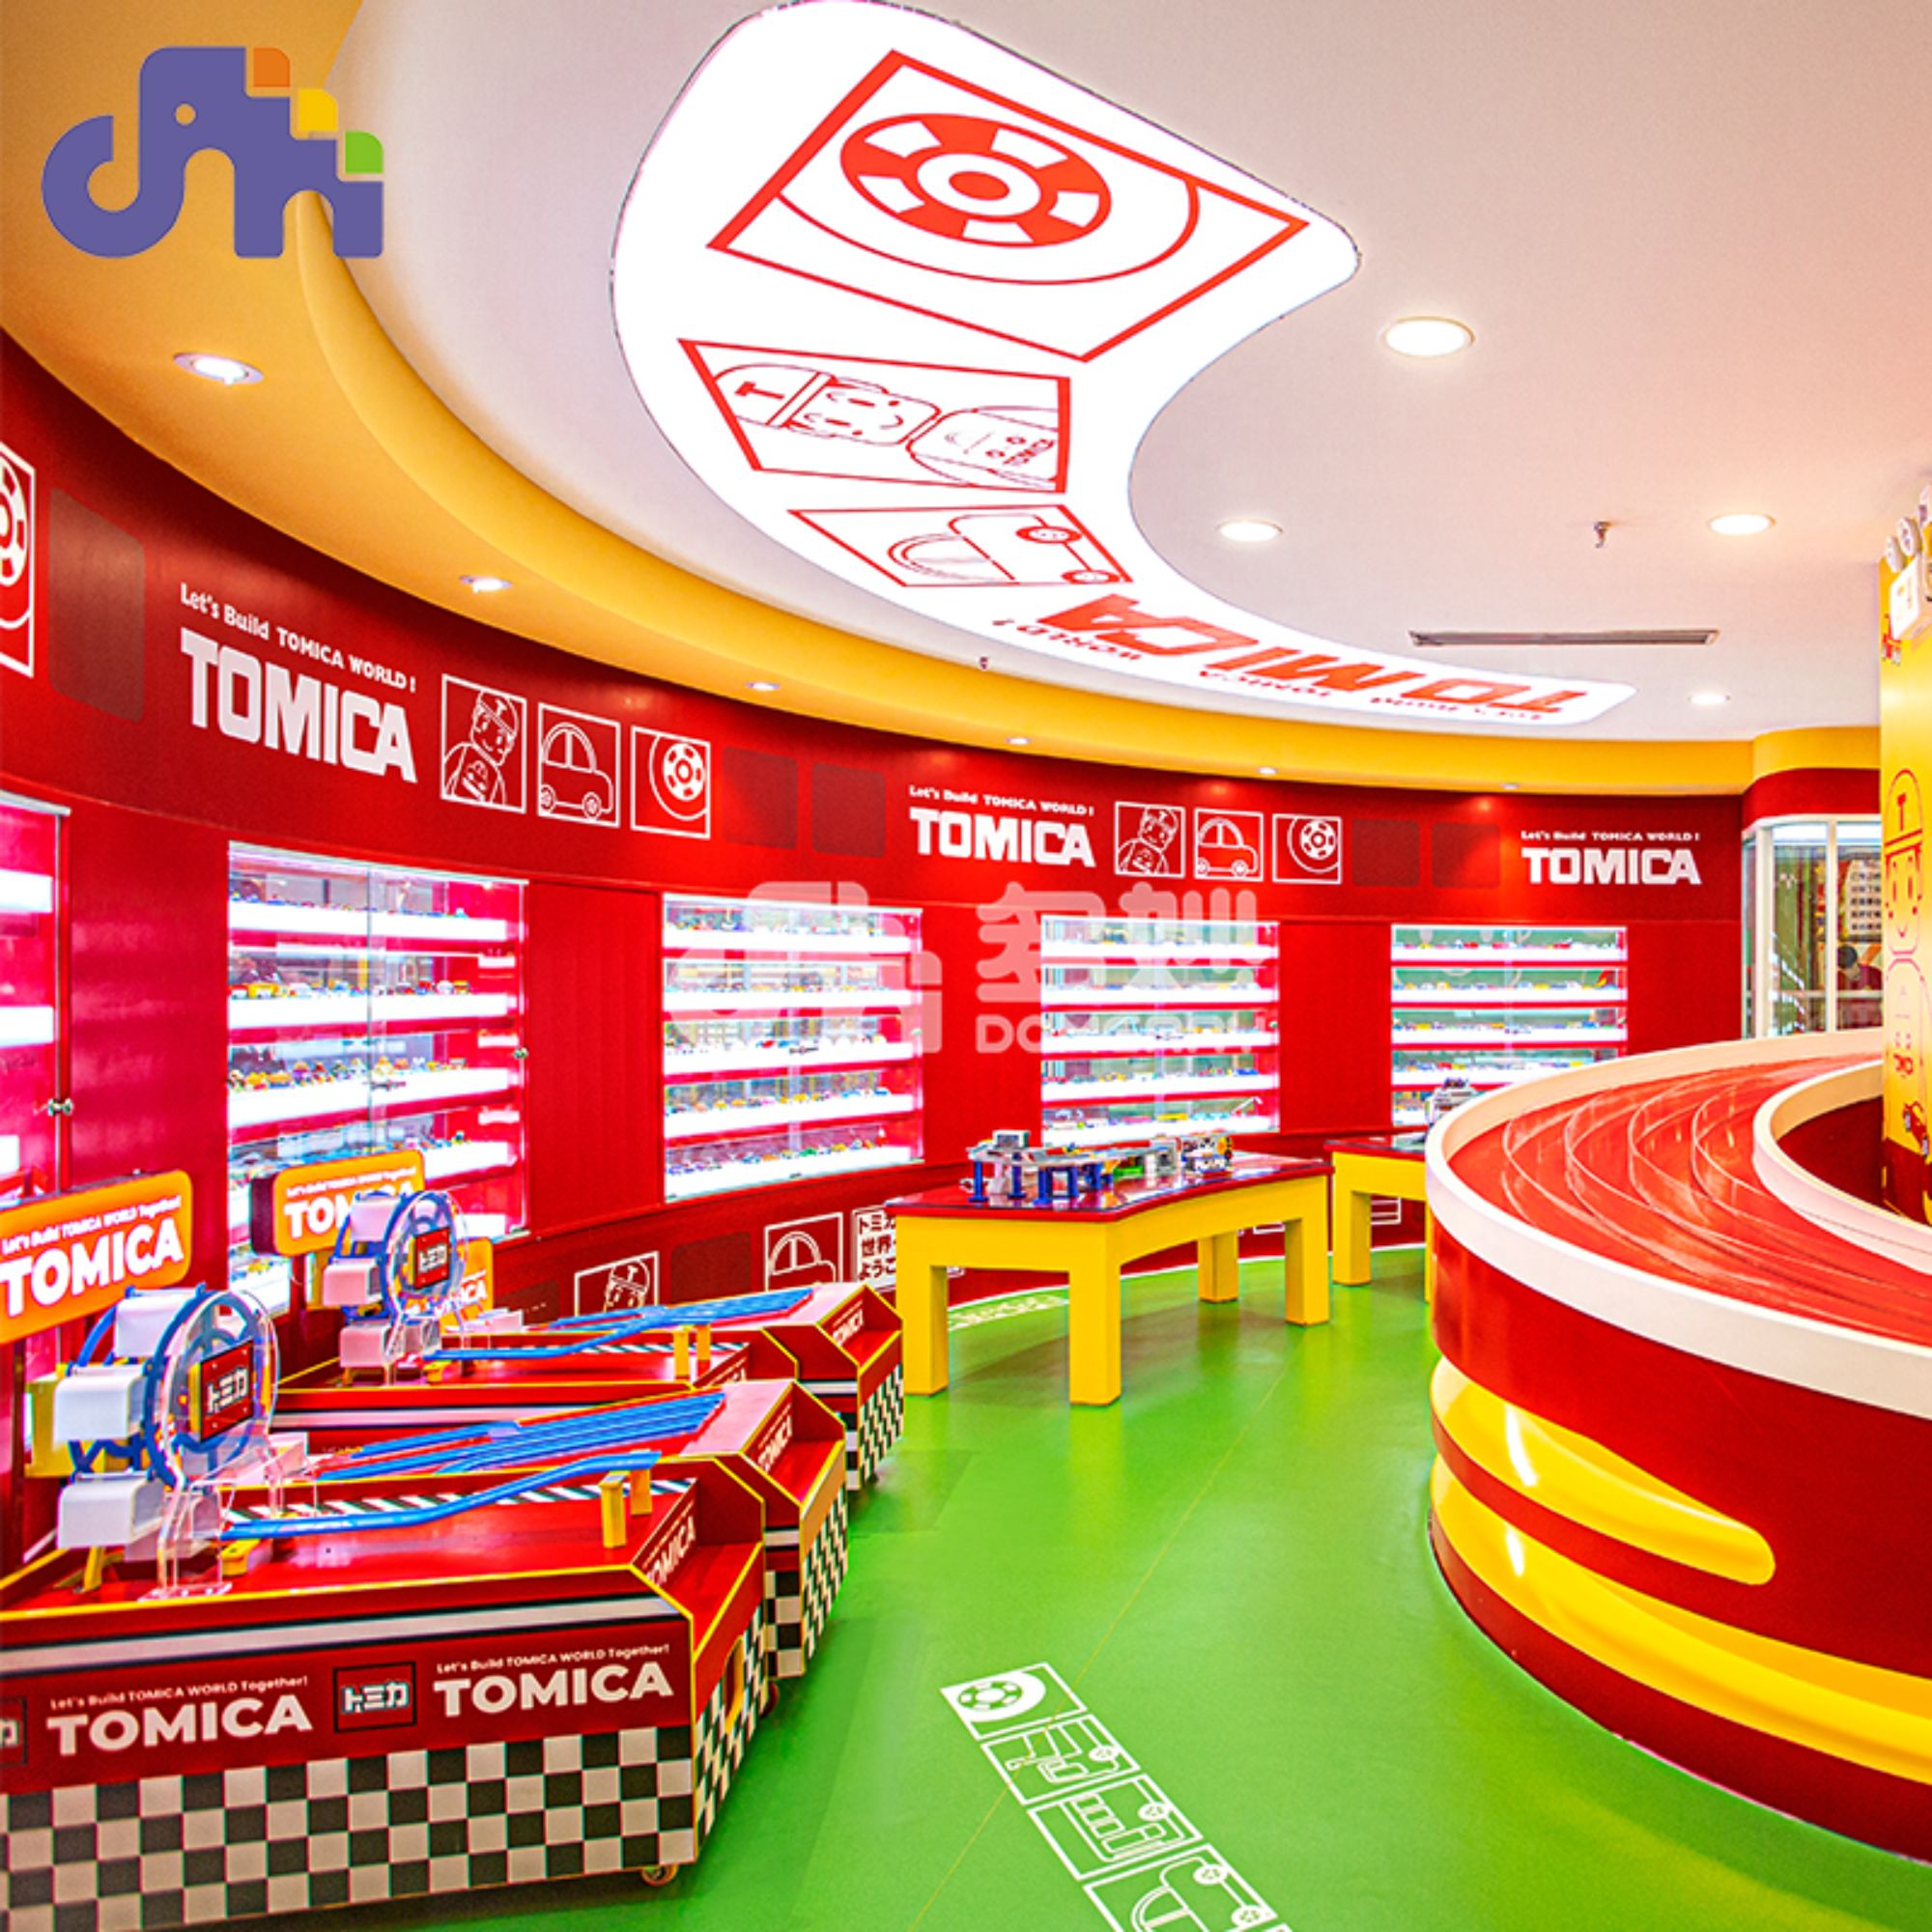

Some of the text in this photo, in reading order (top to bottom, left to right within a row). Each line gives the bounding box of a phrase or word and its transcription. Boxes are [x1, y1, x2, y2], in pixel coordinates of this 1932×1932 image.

[181, 582, 219, 619] Let's
[224, 604, 270, 639] Build
[277, 627, 345, 669] TOMICA
[348, 654, 407, 689] WORLD
[1037, 593, 1586, 713] TOMICA
[181, 627, 417, 782] TOMICA
[983, 794, 1037, 810] TOMICA
[909, 807, 1096, 867] TOMICA
[1592, 831, 1642, 841] TOMICA
[1520, 847, 1701, 884] TOMICA
[0, 1218, 185, 1318] TOMICA
[207, 1368, 248, 1414] トミカ
[506, 1653, 557, 1667] TOMICA
[560, 1648, 605, 1663] WORLD
[128, 1687, 185, 1702] TOMICA
[187, 1681, 238, 1697] WORLD
[241, 1675, 308, 1692] Together!
[341, 1681, 409, 1714] トミカ
[433, 1662, 674, 1718] TOMICA
[46, 1693, 313, 1756] TOMICA
